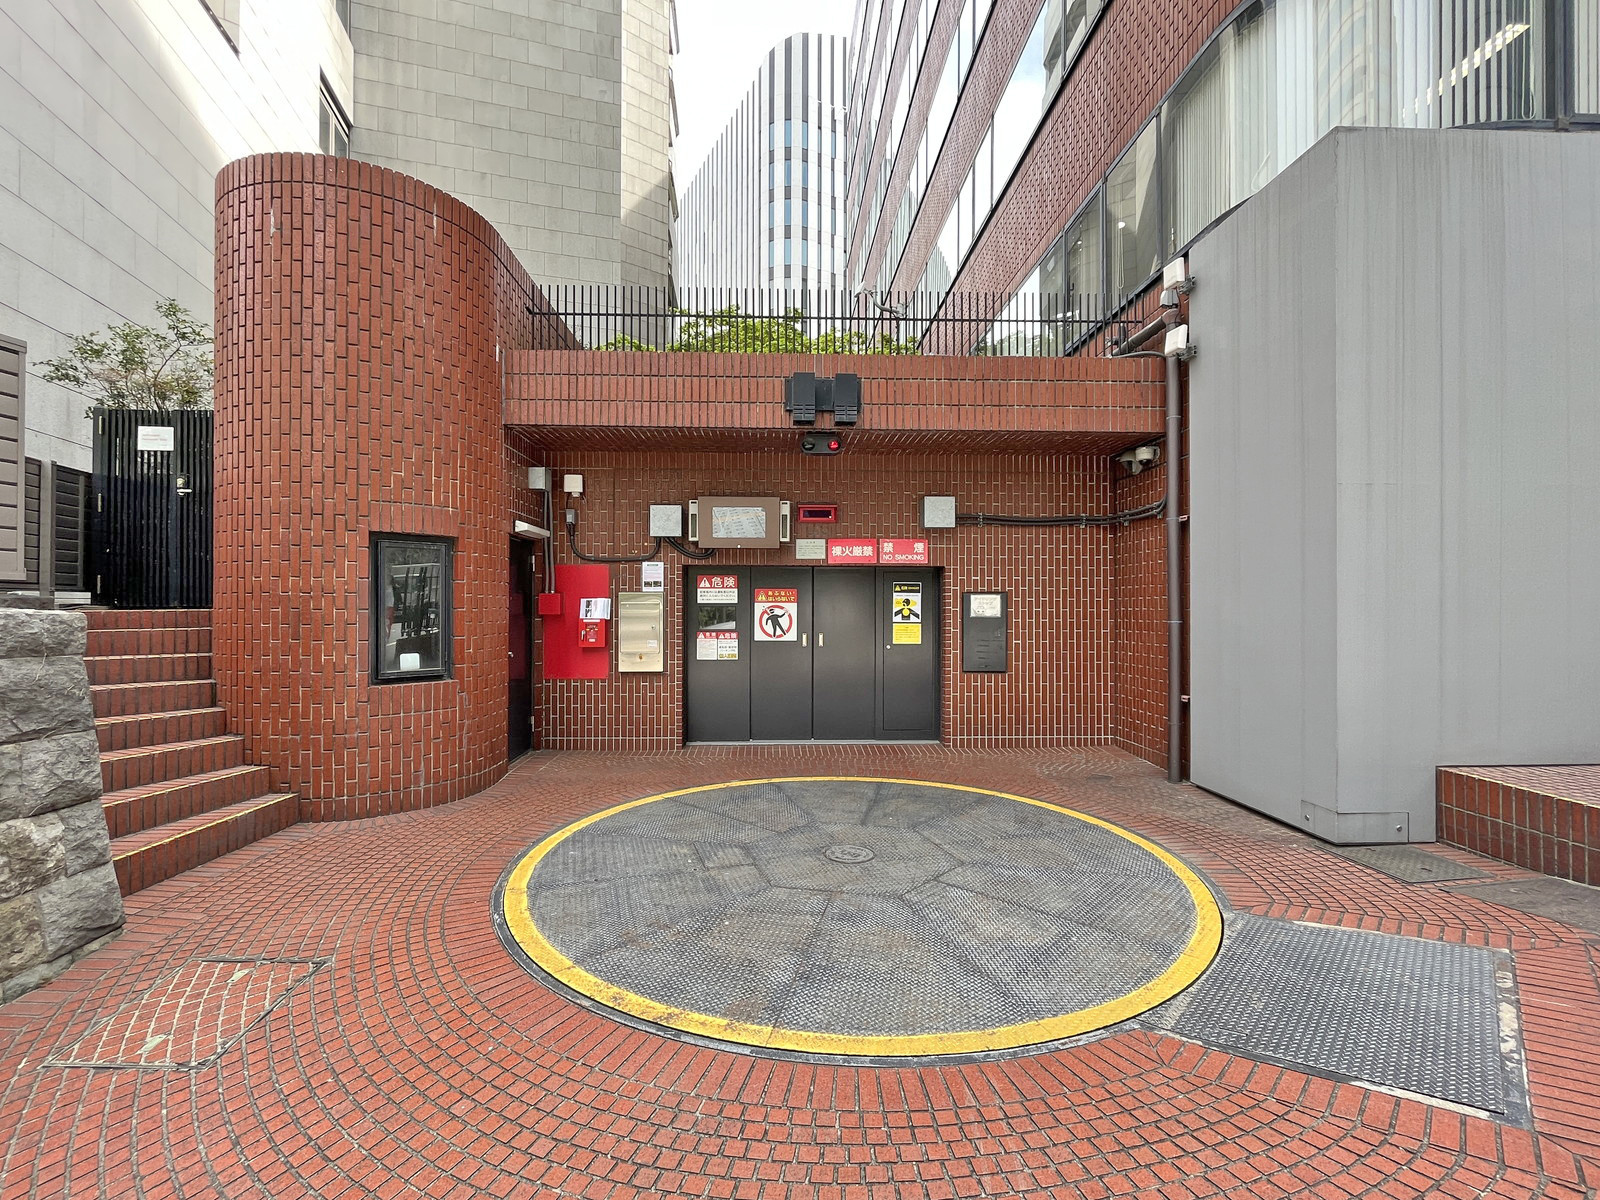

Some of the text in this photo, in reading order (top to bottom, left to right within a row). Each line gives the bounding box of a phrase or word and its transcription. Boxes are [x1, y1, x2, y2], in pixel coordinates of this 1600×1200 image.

[831, 545, 873, 557] 裸火厳禁
[711, 576, 735, 588] 危険
